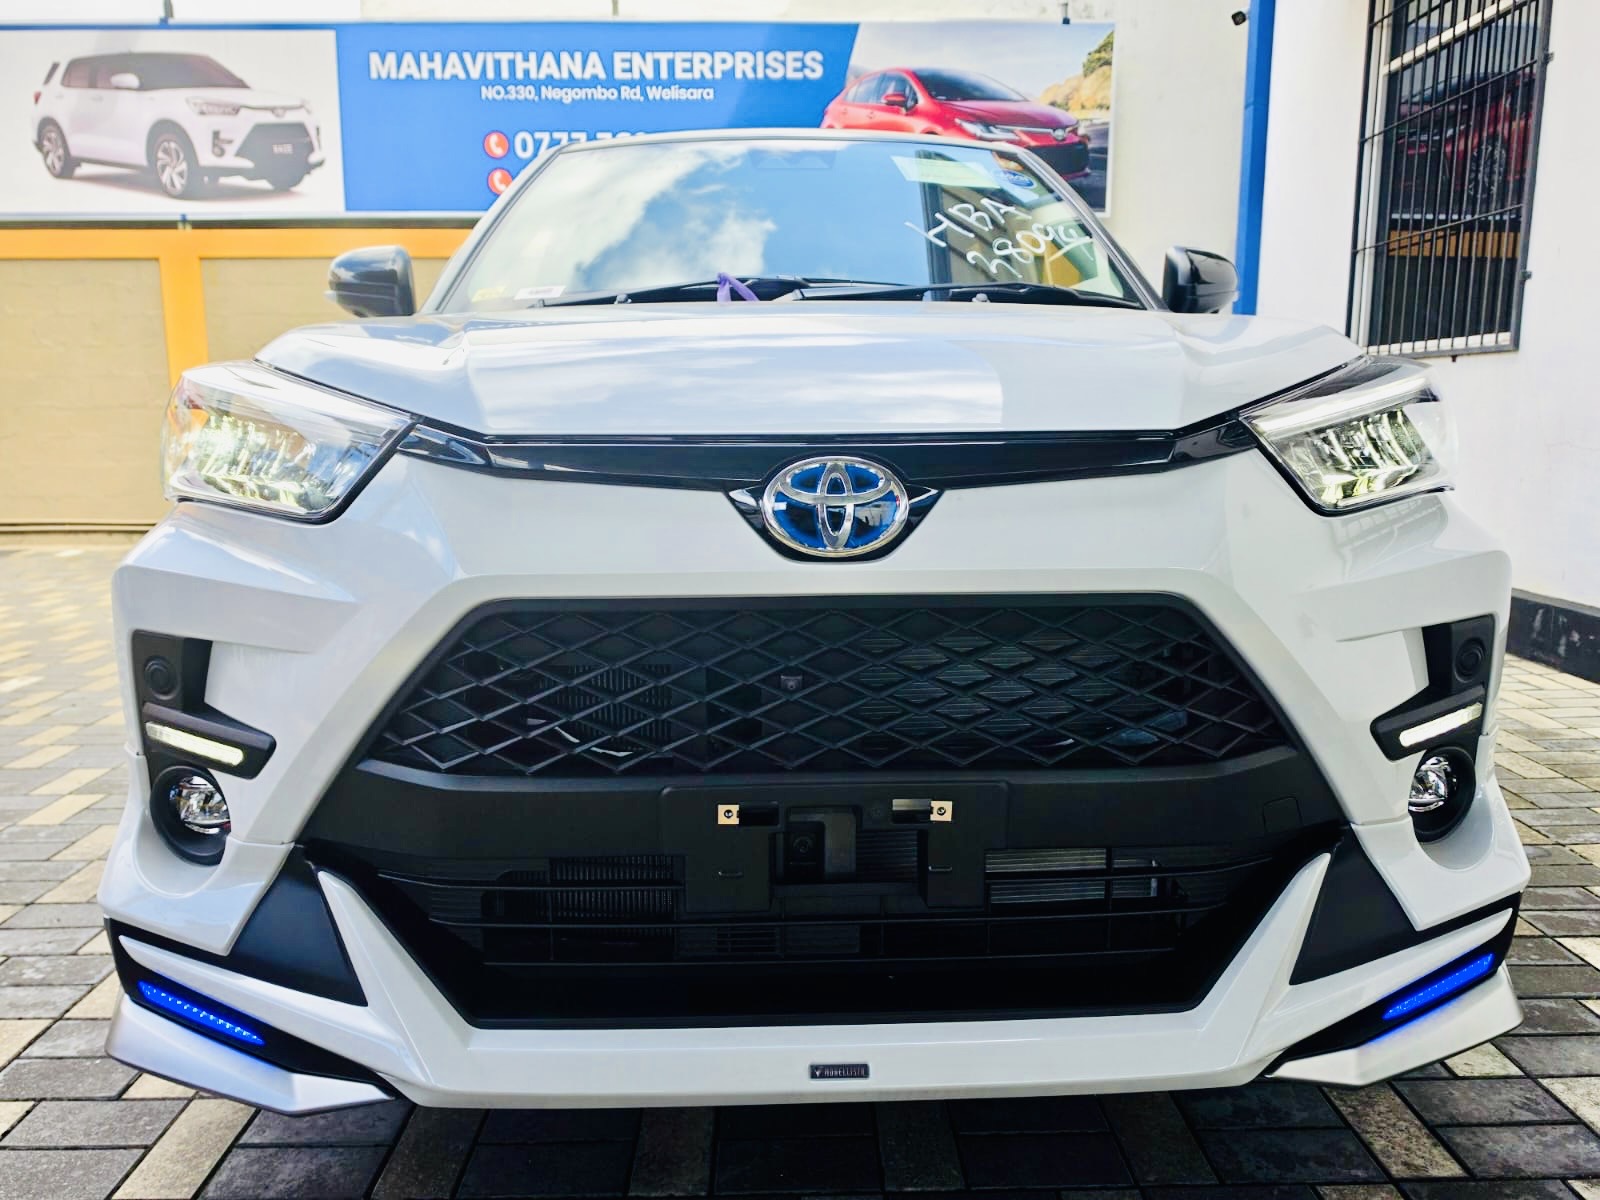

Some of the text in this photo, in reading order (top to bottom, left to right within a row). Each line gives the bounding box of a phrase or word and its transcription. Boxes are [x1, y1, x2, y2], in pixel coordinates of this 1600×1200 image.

[368, 50, 824, 80] MAHAVITHANA ENTERPRISES
[480, 84, 715, 103] NO.330, Negombo Rd, Welisara
